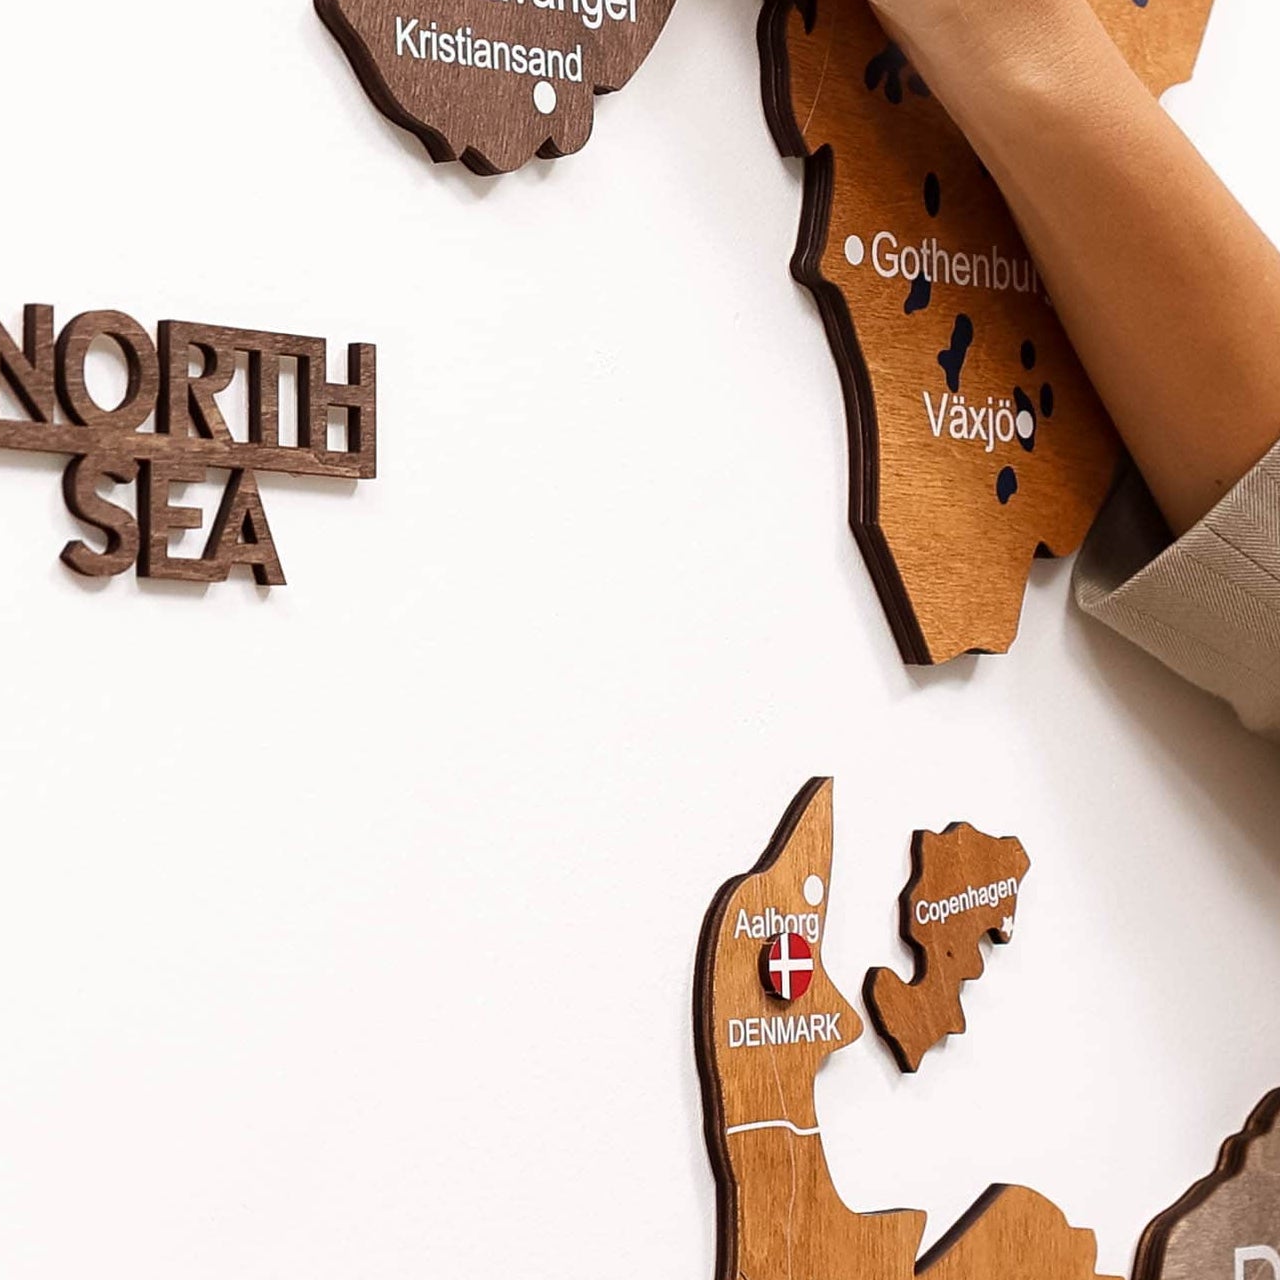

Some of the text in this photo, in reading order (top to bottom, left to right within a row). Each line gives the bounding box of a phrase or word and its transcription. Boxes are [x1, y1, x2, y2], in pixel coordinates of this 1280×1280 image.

[395, 17, 583, 83] Kristiansand
[871, 230, 1052, 306] Gothenbur
[922, 390, 1015, 453] Växjö
[59, 453, 287, 586] SEA
[734, 907, 820, 944] Aalborg
[915, 874, 1019, 926] Copenhagen
[728, 1012, 842, 1049] DENMARK
